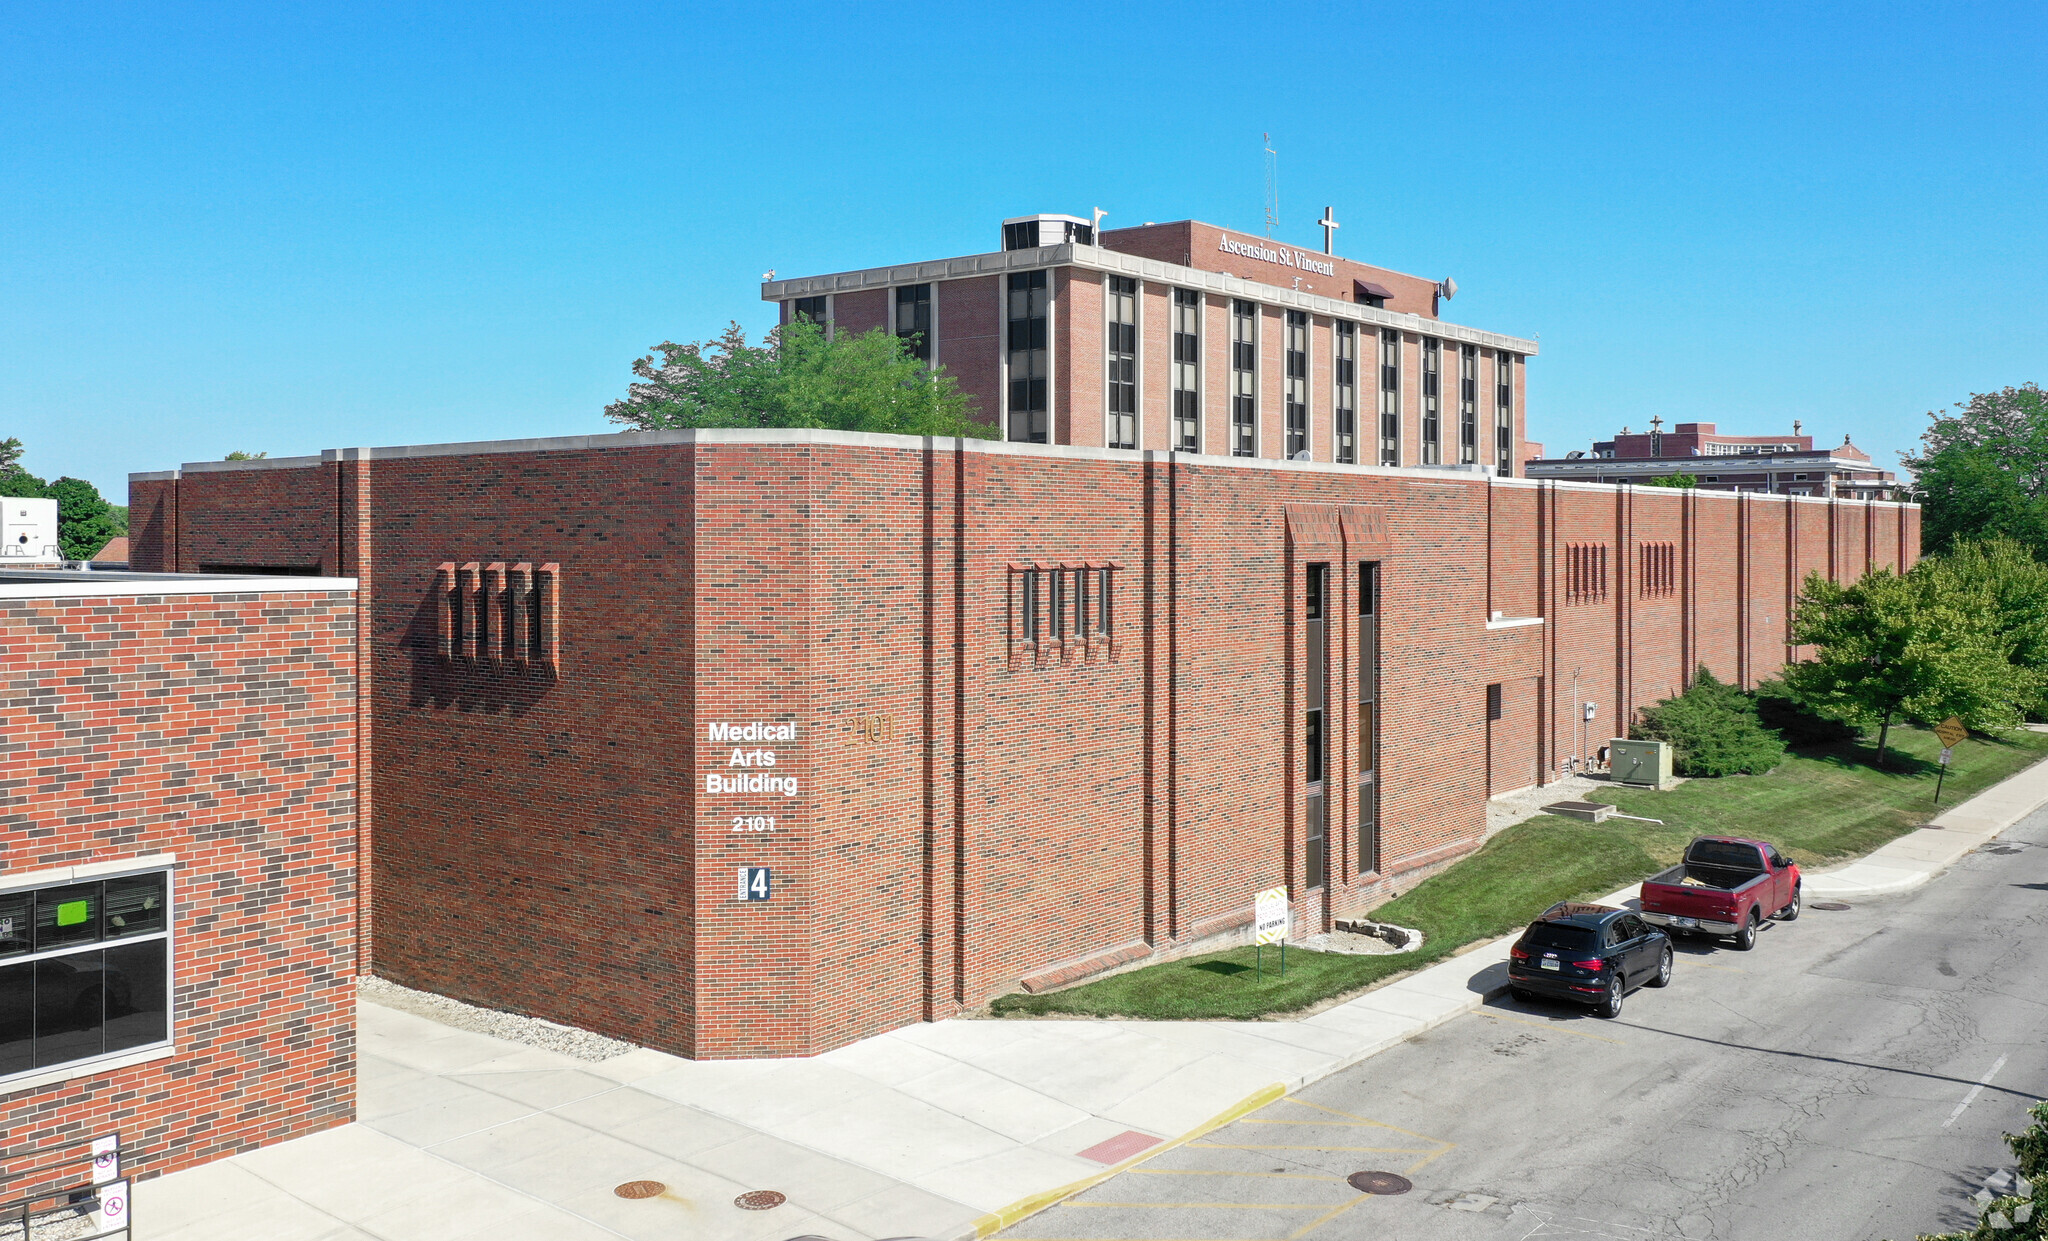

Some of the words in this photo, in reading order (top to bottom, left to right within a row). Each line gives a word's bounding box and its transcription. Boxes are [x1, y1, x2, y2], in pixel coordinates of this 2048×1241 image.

[1218, 233, 1277, 264] Ascension
[1279, 247, 1294, 267] St.
[1294, 251, 1334, 277] Vincent
[708, 722, 796, 741] Medical
[845, 713, 893, 746] 2101
[1940, 723, 1963, 732] CAUTION
[728, 748, 776, 767] Arts
[706, 773, 798, 796] Building
[732, 817, 775, 831] 2101
[739, 870, 747, 899] ENTRANCE
[751, 869, 768, 898] 4
[1266, 917, 1286, 930] PARKING
